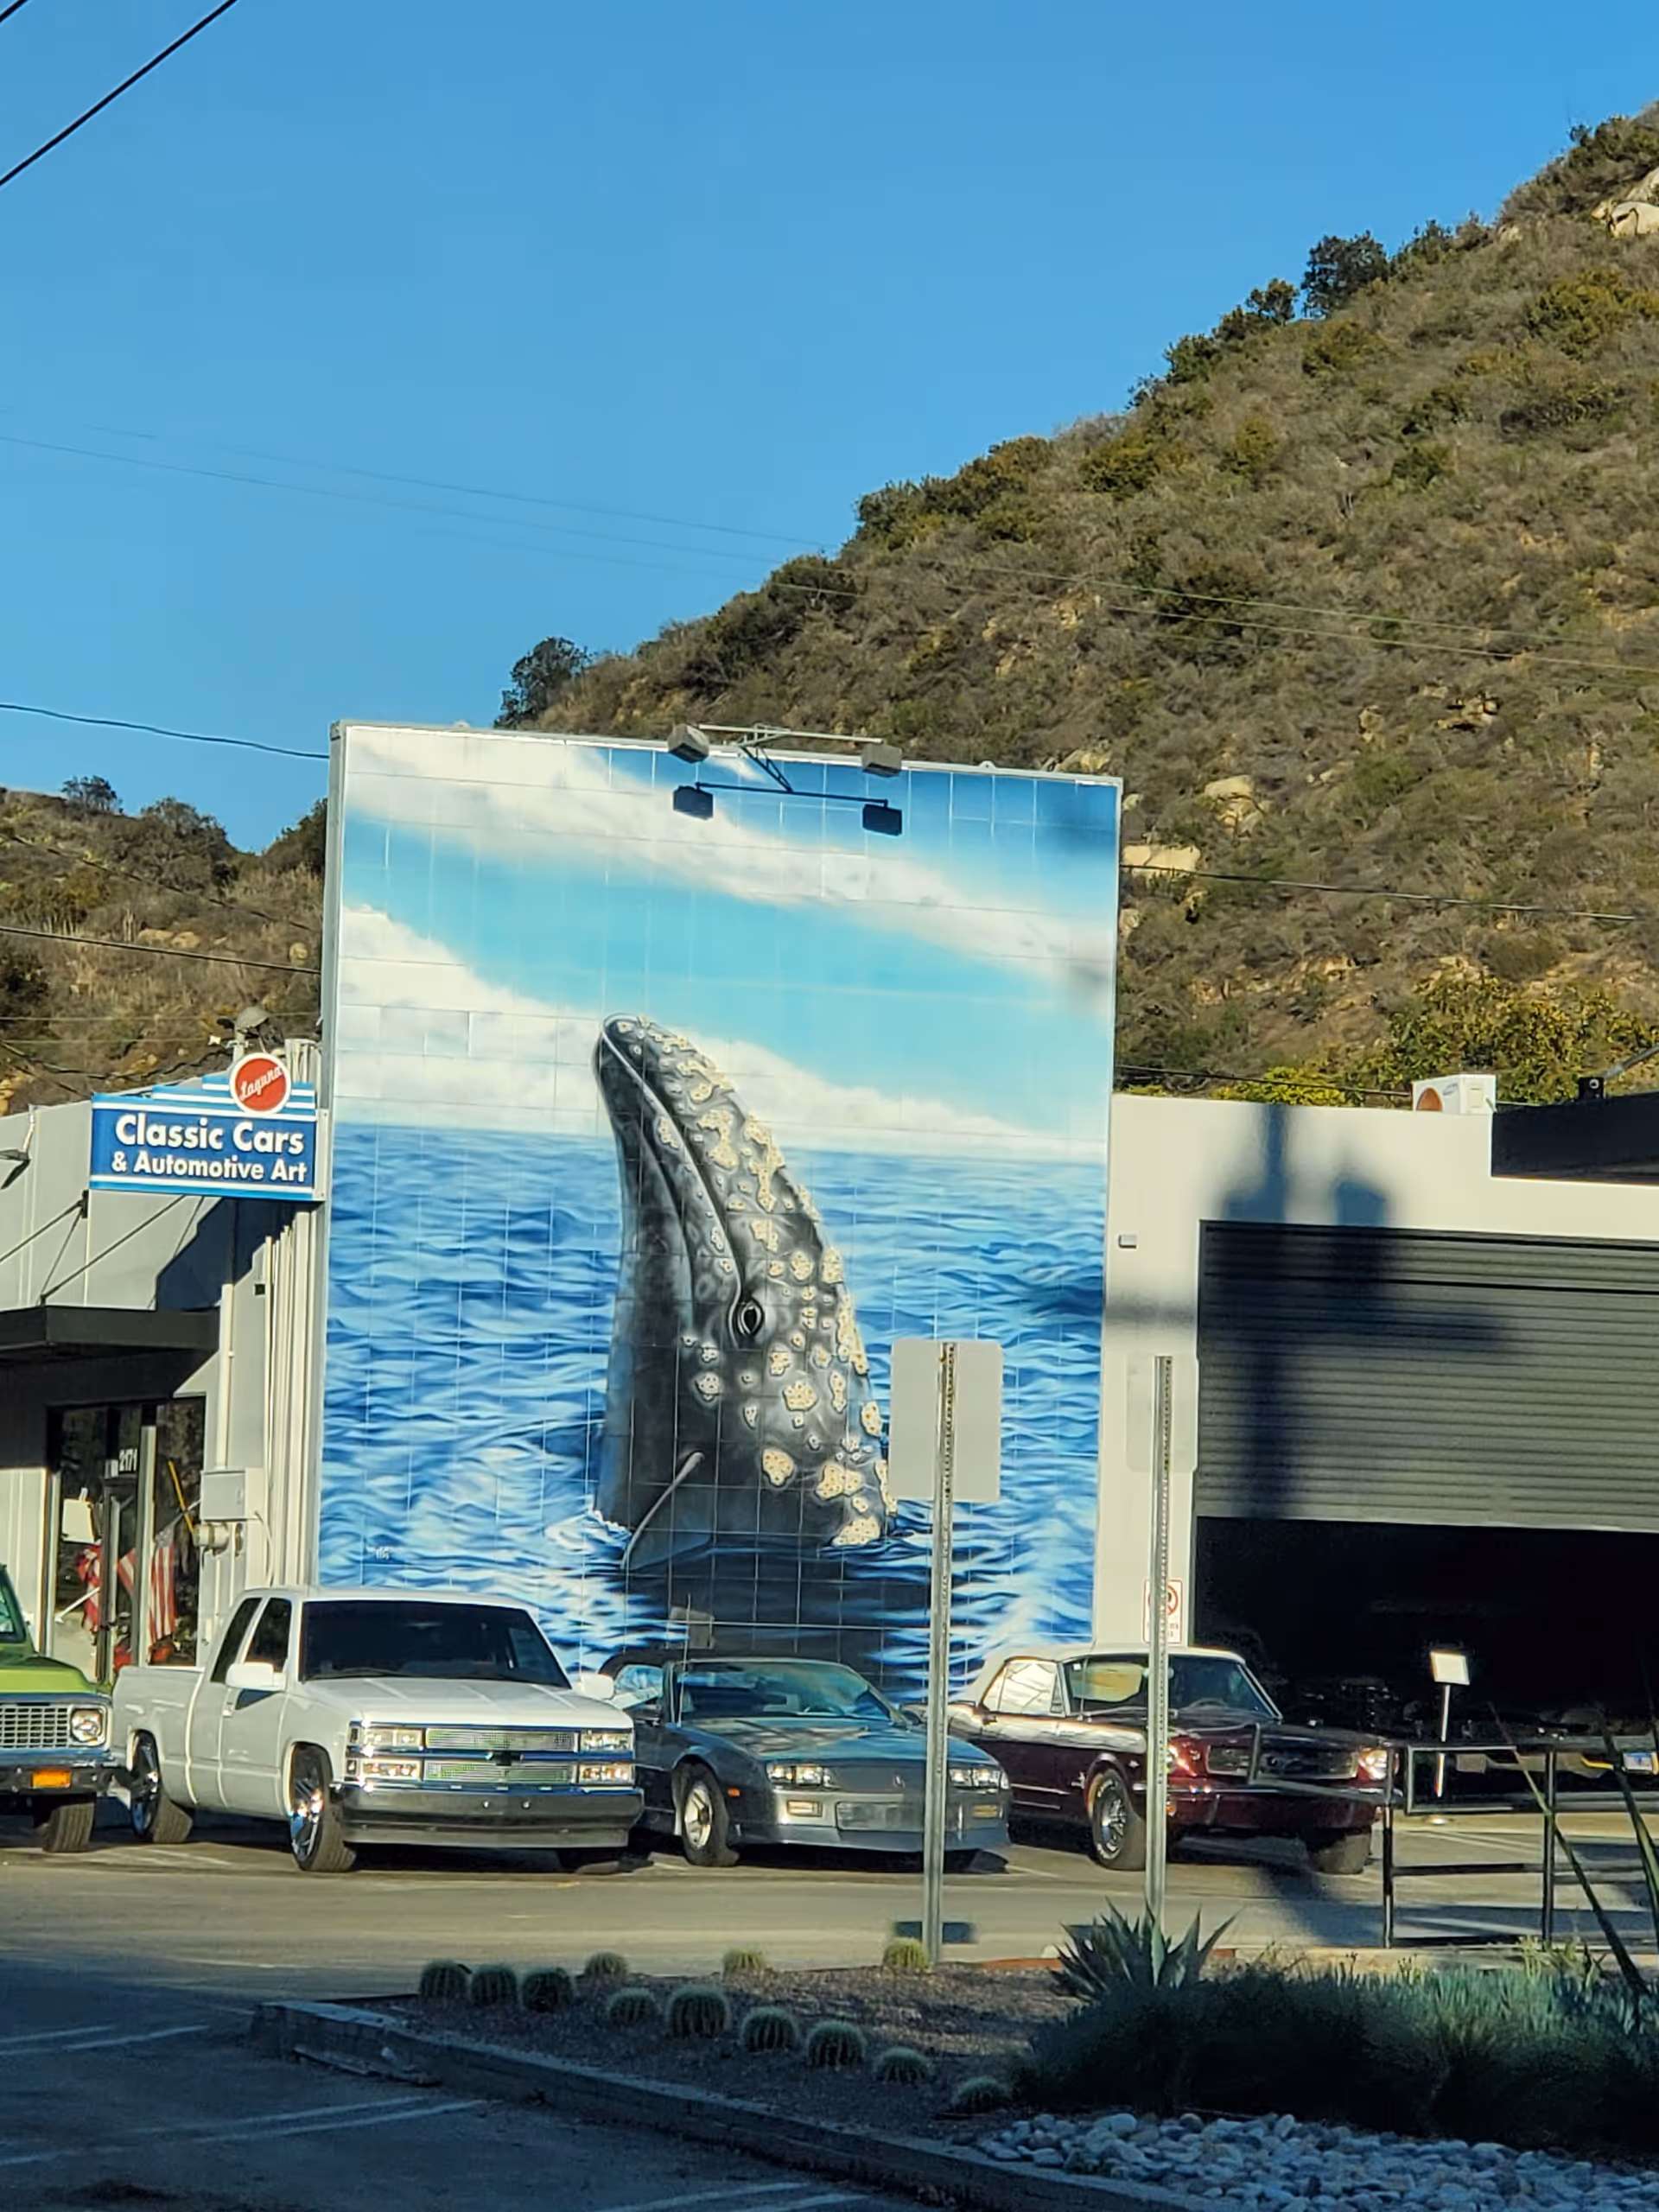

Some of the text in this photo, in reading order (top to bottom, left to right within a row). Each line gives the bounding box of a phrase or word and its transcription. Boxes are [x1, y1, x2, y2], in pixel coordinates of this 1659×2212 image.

[239, 1066, 283, 1102] Laguna
[115, 1113, 304, 1154] Classic Cars
[111, 1150, 307, 1182] & Automotive Art
